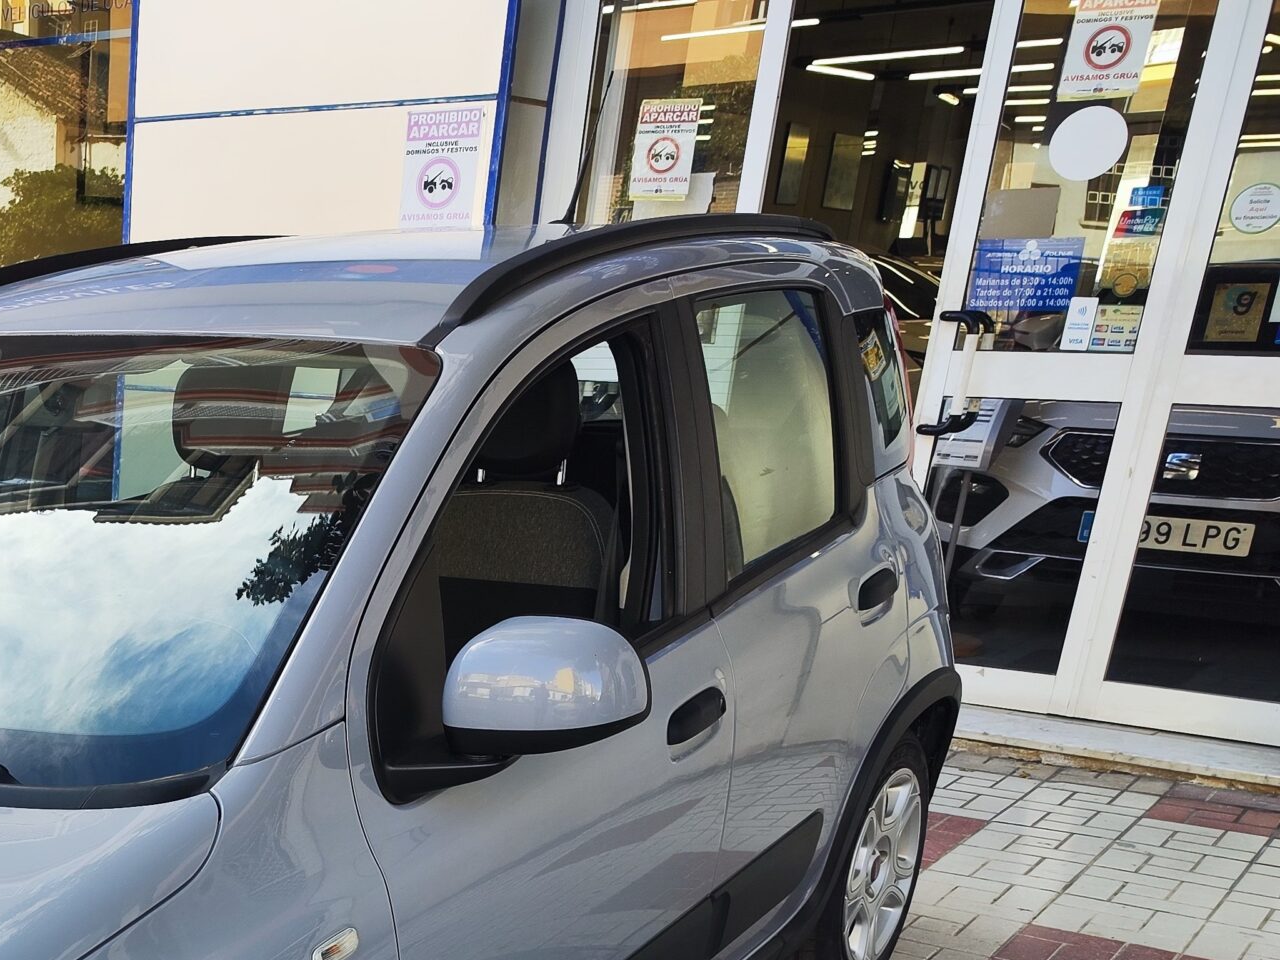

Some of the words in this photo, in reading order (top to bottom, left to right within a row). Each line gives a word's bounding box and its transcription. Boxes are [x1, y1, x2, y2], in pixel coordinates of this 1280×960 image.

[1098, 9, 1134, 17] INCLUSIVE
[1063, 73, 1110, 82] AVISAMOS
[643, 103, 699, 113] PROHIBIDO
[410, 109, 480, 126] PROHIBIDO
[642, 111, 697, 123] APARCAR
[409, 122, 479, 139] APARCAR
[425, 140, 459, 148] INCLUSIVE
[406, 148, 440, 156] DOMINGOS
[401, 212, 444, 222] AVISAMOS
[1120, 215, 1160, 226] UnionPay
[1001, 264, 1052, 274] HORARIO
[1010, 277, 1020, 286] de
[1022, 277, 1039, 286] 9:30
[976, 288, 1000, 297] Tardes
[1002, 288, 1012, 296] de
[1014, 288, 1034, 296] 17:00
[1004, 299, 1014, 307] de
[1181, 523, 1242, 551] LPG
